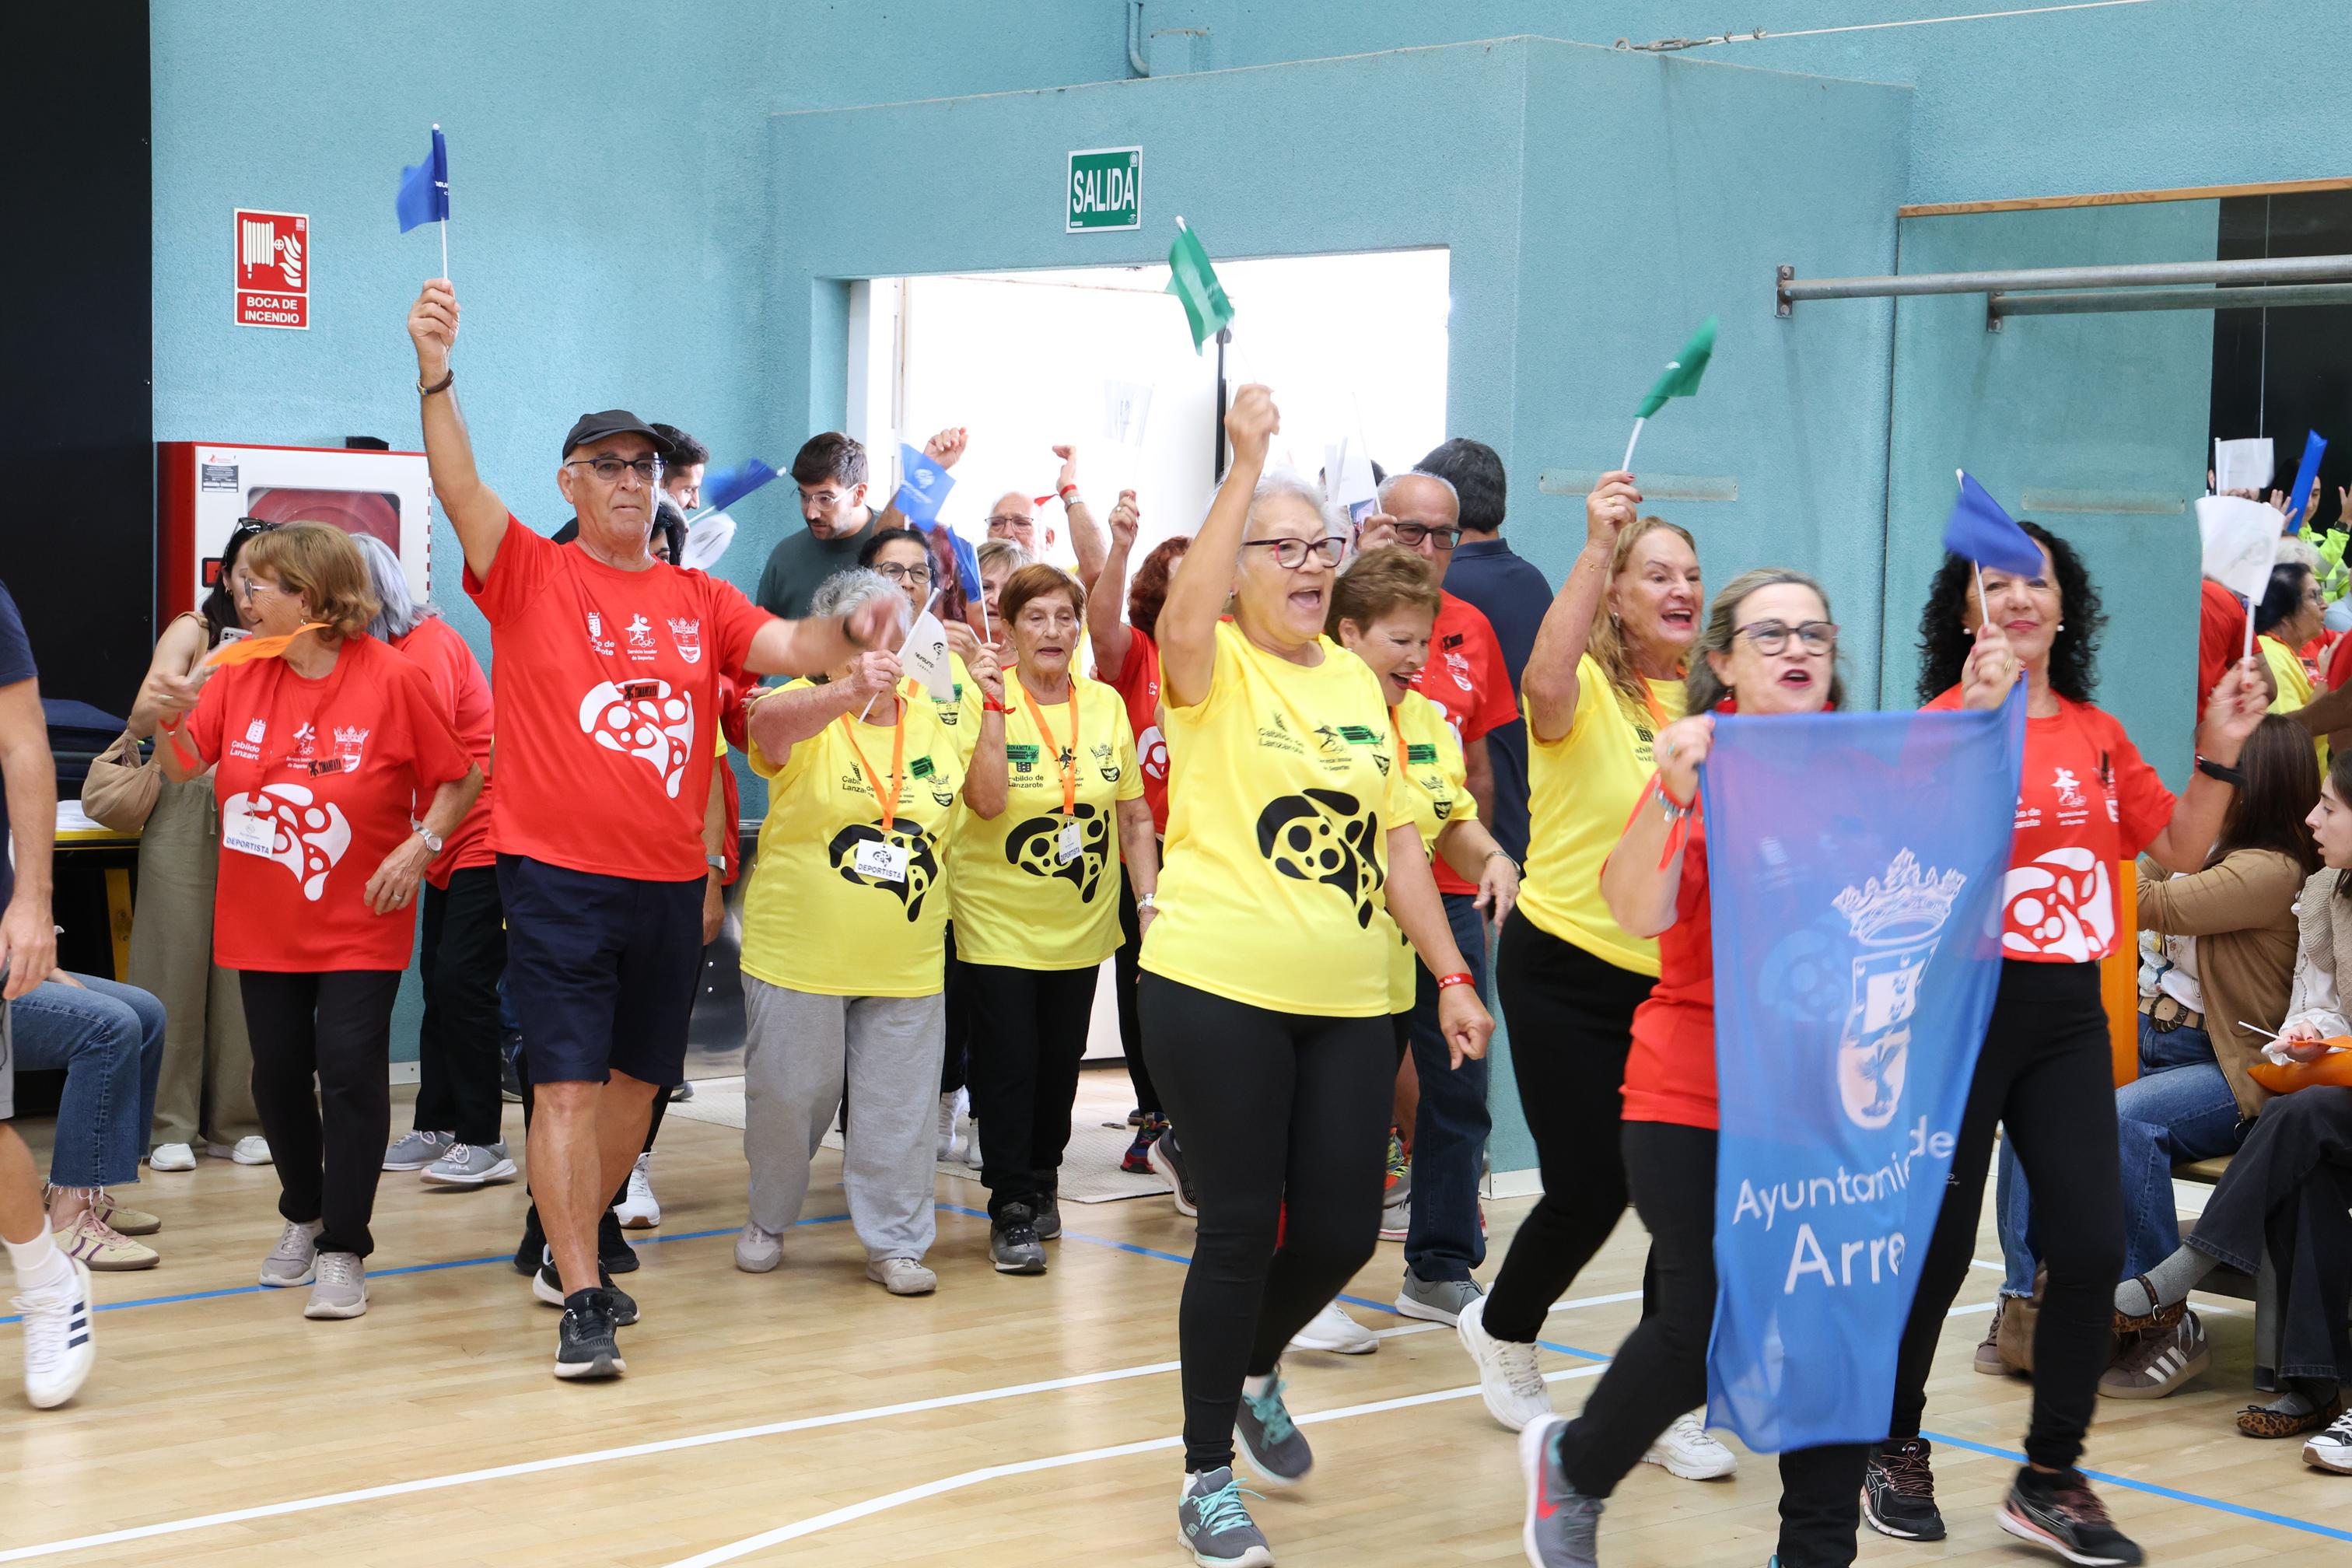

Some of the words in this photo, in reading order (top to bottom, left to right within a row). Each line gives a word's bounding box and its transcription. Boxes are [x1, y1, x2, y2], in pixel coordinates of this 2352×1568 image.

[1073, 166, 1136, 214] SALIDA
[247, 296, 280, 309] BOCA
[282, 299, 298, 310] DE
[244, 310, 299, 324] INCENDIO
[229, 747, 260, 761] Lanzar
[231, 740, 261, 753] Cabildo
[1008, 780, 1044, 789] Lanzarote
[226, 836, 269, 855] DEPORTISTA
[858, 863, 901, 879] DEPORTISTA
[1908, 1115, 1955, 1159] de
[1783, 1222, 1906, 1295] Arre
